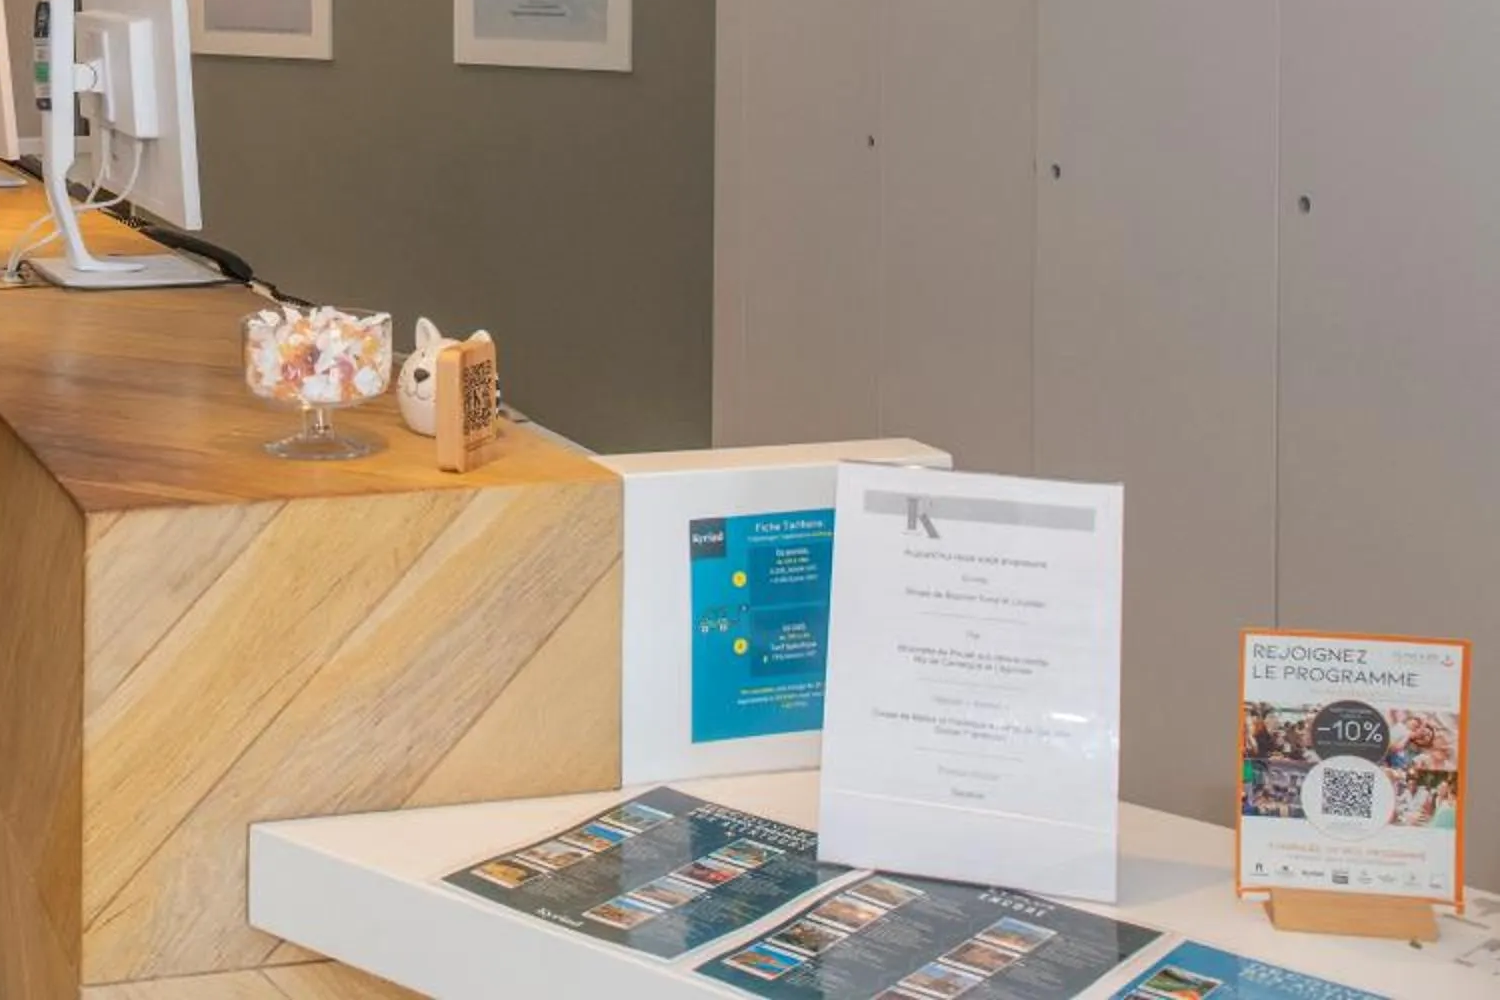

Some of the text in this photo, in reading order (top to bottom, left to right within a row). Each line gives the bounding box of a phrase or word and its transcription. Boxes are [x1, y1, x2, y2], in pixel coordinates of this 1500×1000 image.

[692, 530, 725, 546] Kyriad
[1252, 642, 1368, 665] REJOIGNEZ
[1252, 664, 1421, 688] LE PROGRAMME
[1317, 719, 1383, 743] -10%
